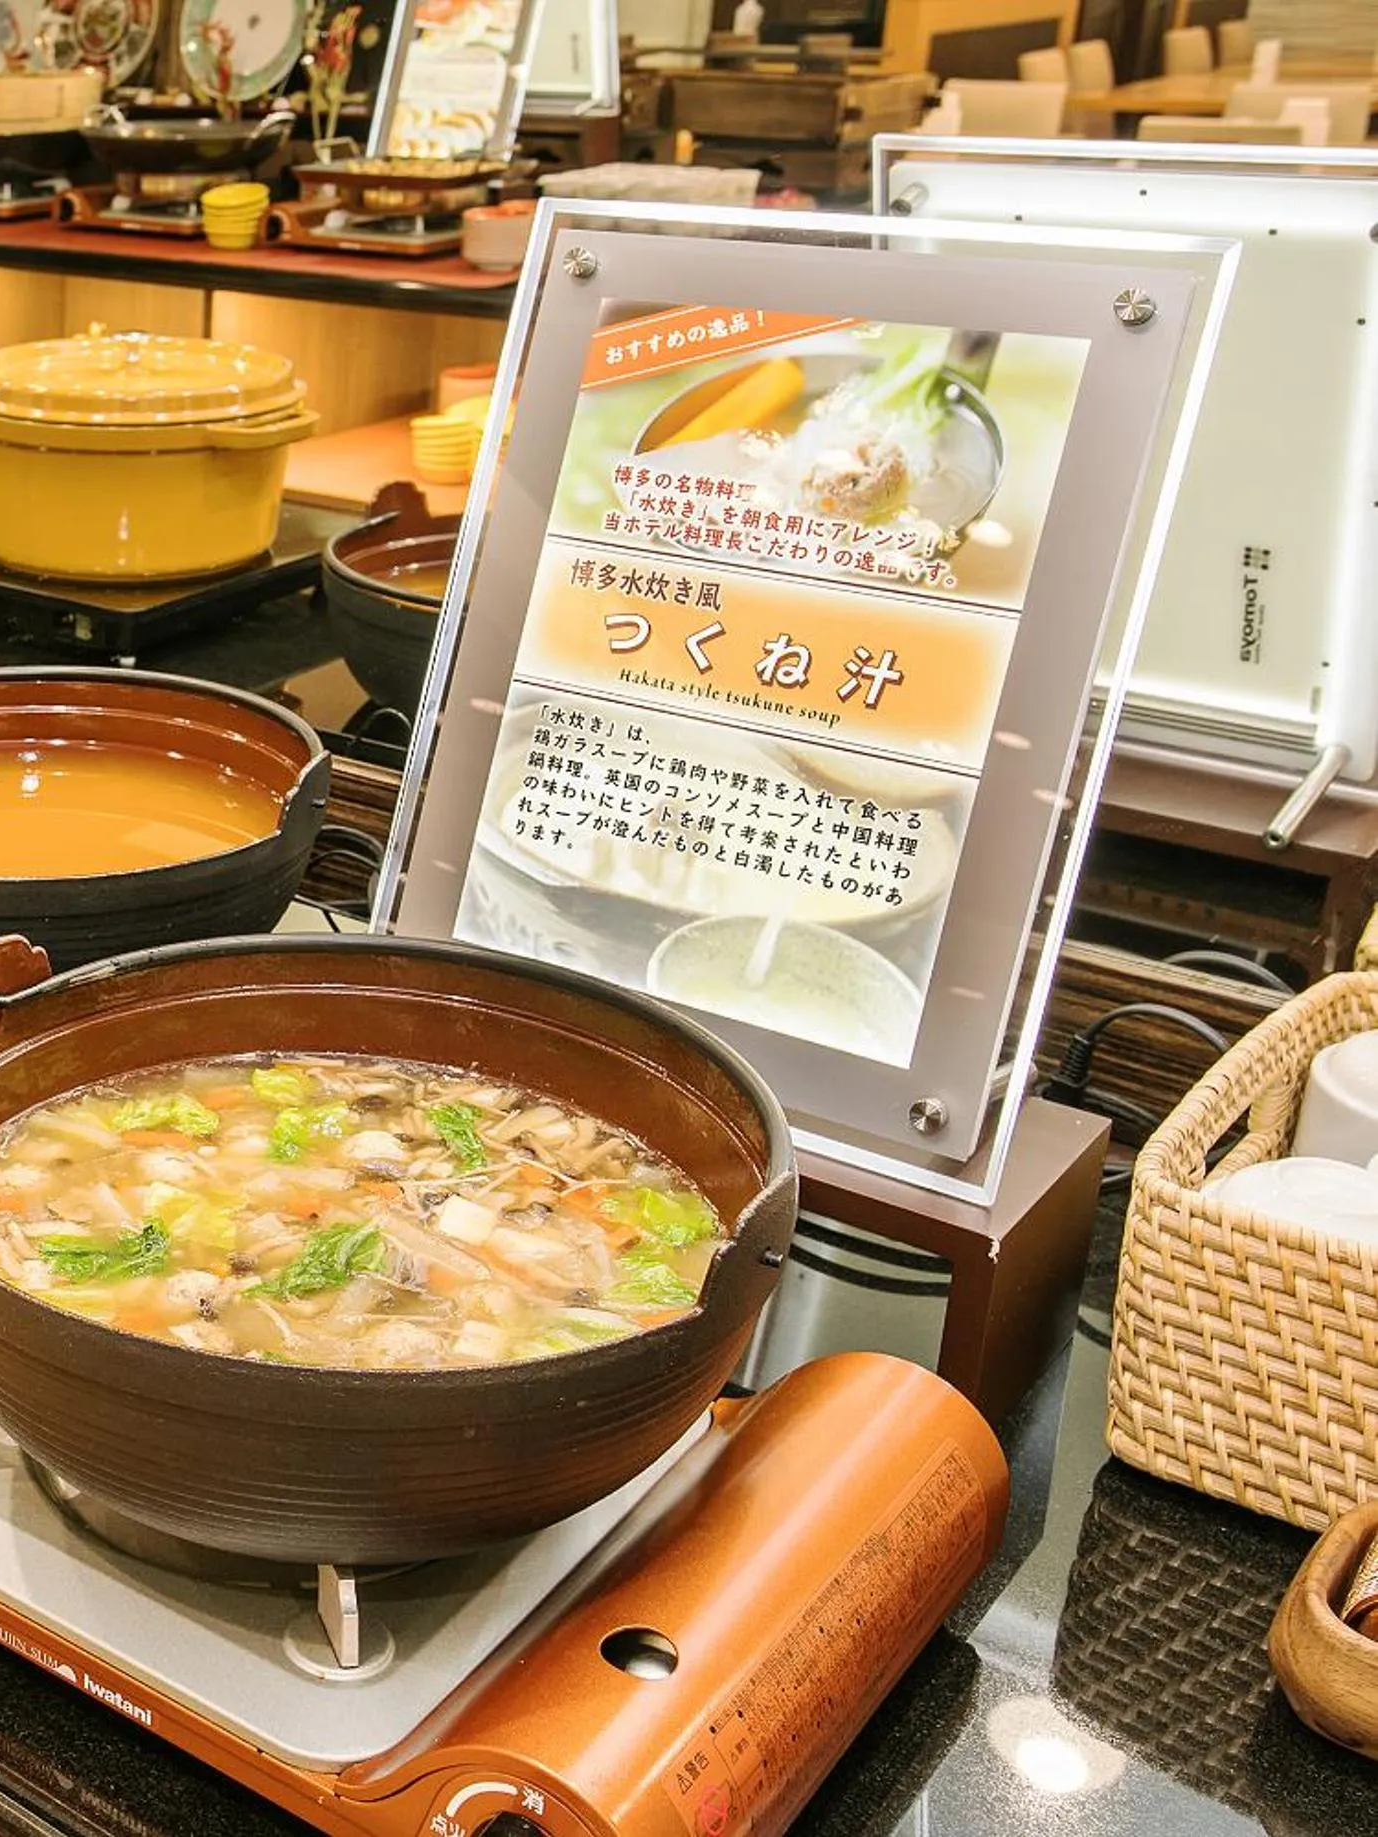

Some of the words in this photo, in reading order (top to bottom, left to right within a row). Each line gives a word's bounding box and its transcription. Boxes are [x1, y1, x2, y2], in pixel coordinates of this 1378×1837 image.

[605, 309, 766, 365] おすすめの逸品！
[571, 558, 723, 612] 博多水炊き風
[604, 613, 905, 710] つくね汁
[536, 704, 651, 746] 「水炊き」は、
[619, 667, 675, 693] Hakata
[679, 682, 720, 705] style
[725, 689, 795, 717] tsukune
[798, 707, 842, 729] soup
[528, 751, 919, 857] 鍋料理。英国のコンソメスープと中国料理
[533, 728, 923, 830] 鶏ガラスープに鶏肉や野菜を入れて食べる
[515, 818, 575, 851] ります。
[518, 797, 904, 907] れスープが澄んだものと白濁したものがあ
[523, 775, 912, 881] の味わいにヒントを得て考案されたといわ
[83, 1673, 153, 1727] Iwatani
